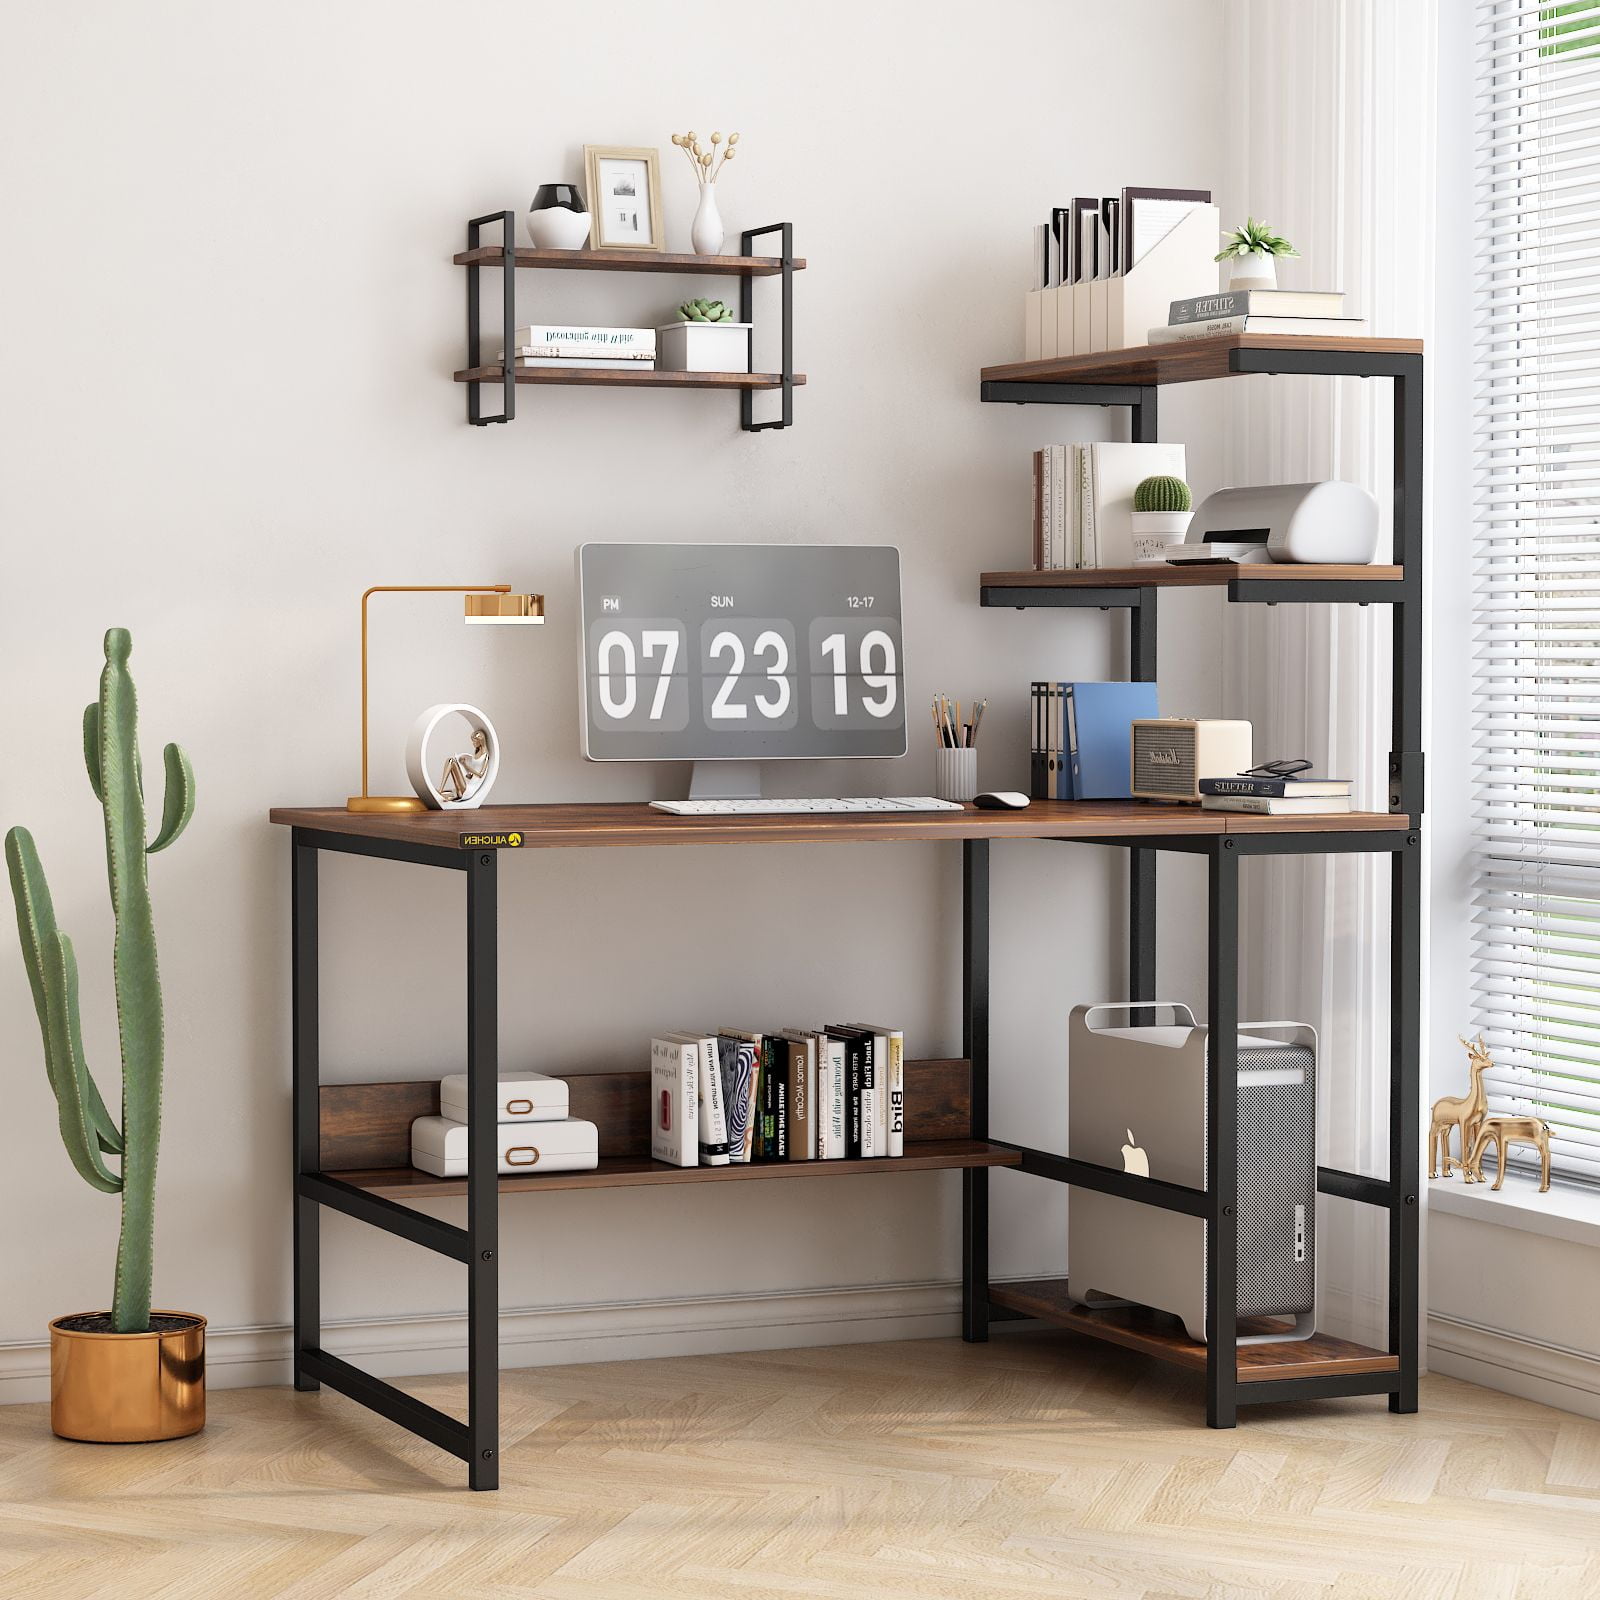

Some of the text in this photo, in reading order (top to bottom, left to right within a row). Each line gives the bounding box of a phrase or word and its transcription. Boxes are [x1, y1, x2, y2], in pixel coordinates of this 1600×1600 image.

[603, 598, 619, 610] PM
[711, 596, 734, 608] SUN
[847, 596, 874, 609] 12-17
[598, 630, 897, 719] 07 23 19
[1214, 782, 1255, 791] STIFTER
